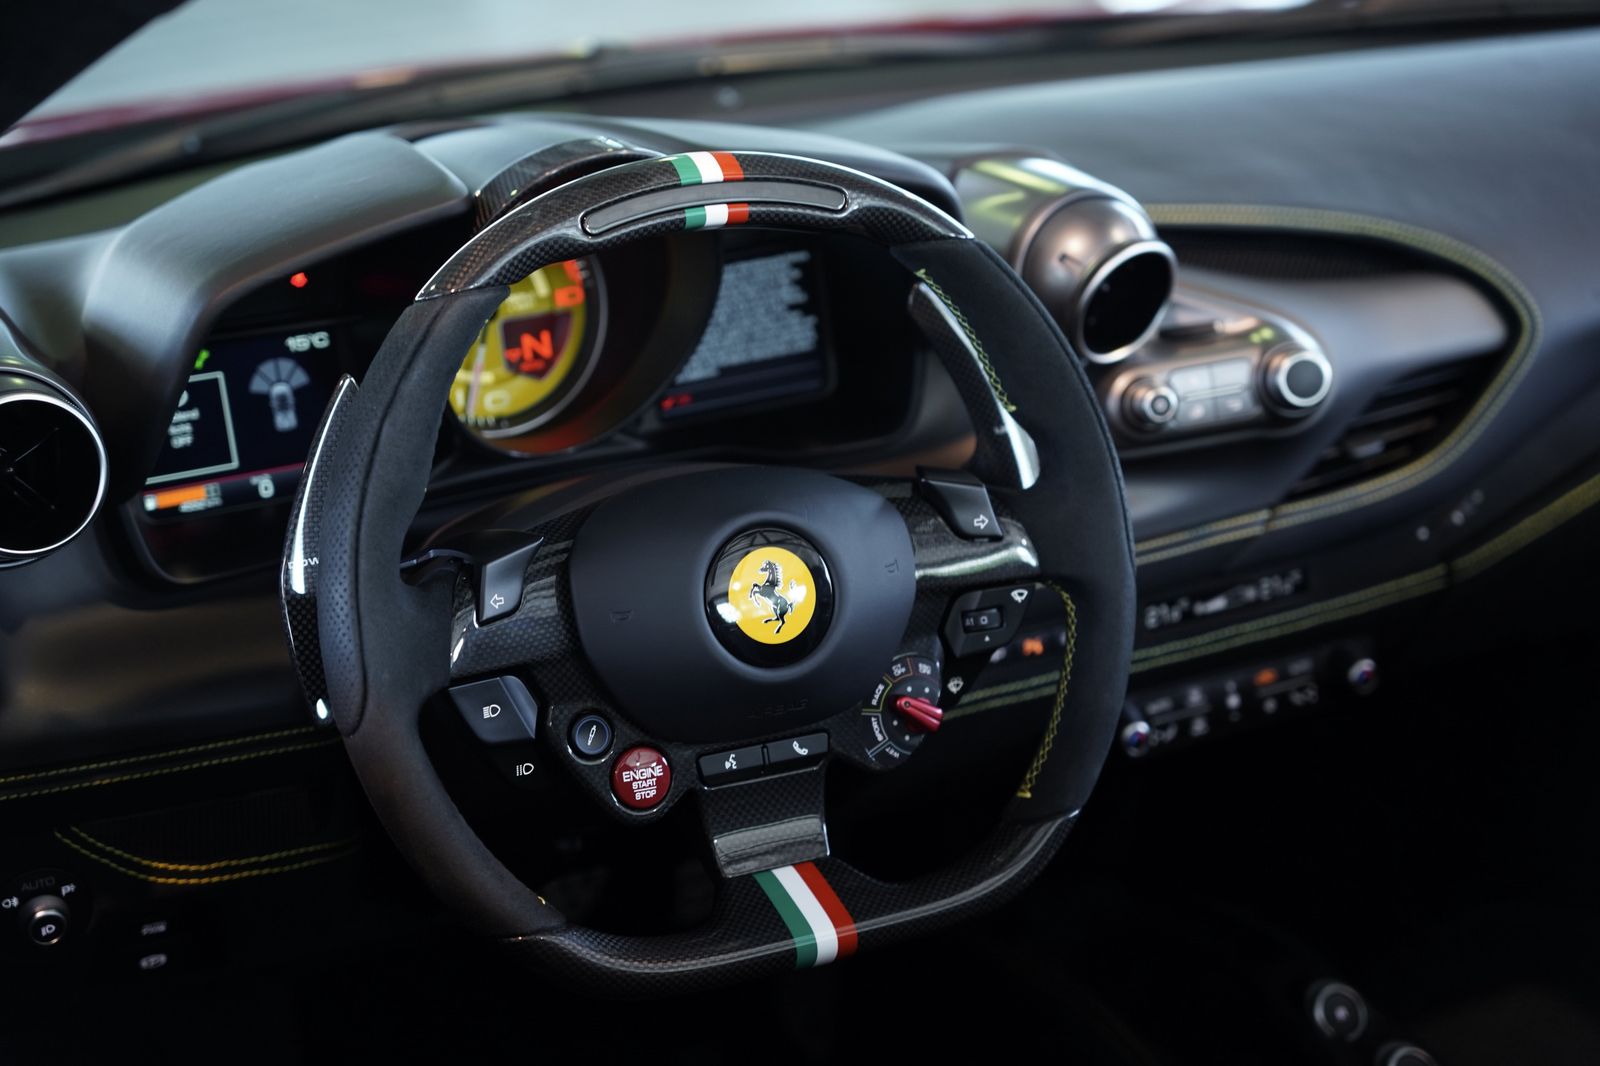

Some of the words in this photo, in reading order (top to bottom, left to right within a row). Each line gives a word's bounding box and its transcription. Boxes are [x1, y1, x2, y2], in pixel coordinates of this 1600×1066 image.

[520, 329, 553, 361] N
[871, 683, 885, 705] RACE
[871, 716, 884, 742] SPORT
[885, 746, 900, 758] WET
[622, 765, 663, 782] ENGINE
[632, 778, 657, 789] START
[635, 790, 657, 800] STOP
[22, 876, 56, 892] AUTO
